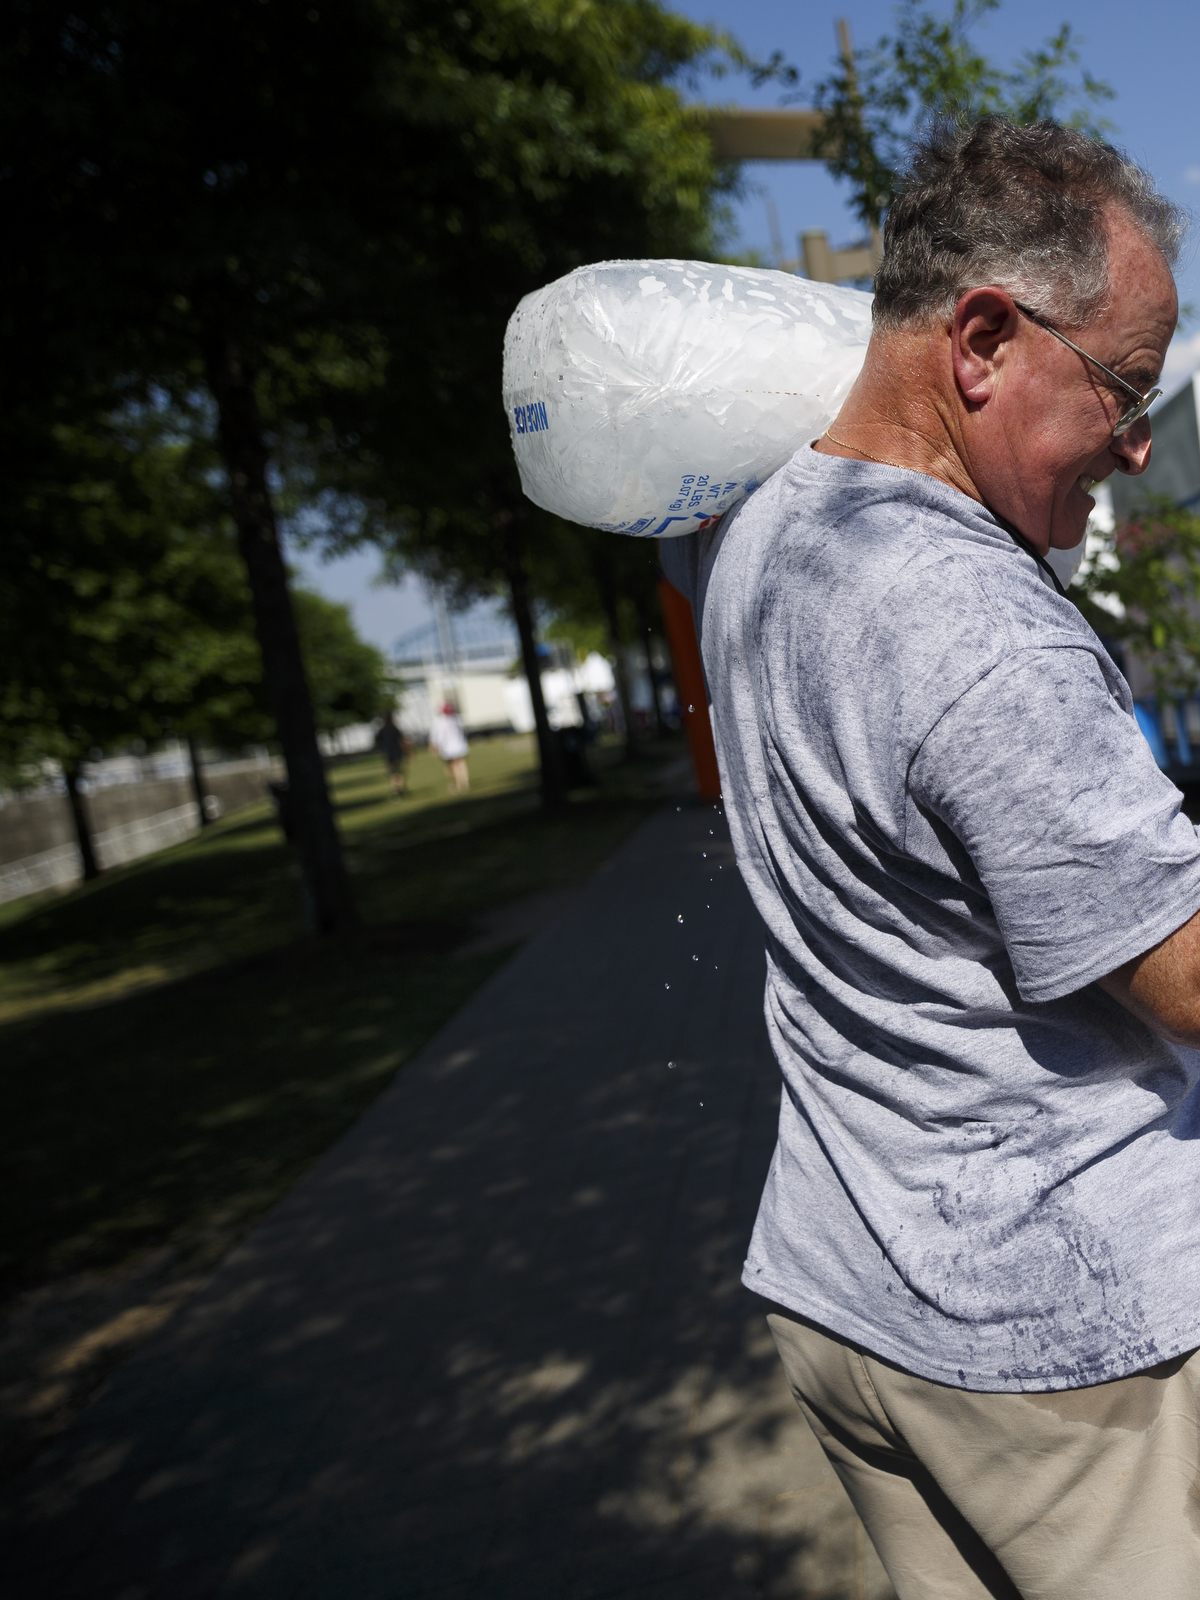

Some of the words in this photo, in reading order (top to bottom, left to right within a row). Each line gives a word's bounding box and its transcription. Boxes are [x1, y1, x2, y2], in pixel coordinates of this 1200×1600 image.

[526, 402, 549, 432] NICE
[679, 475, 696, 497] (9.07
[696, 475, 709, 486] 20
[686, 489, 705, 509] LBS.
[705, 484, 721, 500] WT.
[668, 498, 686, 511] kg)
